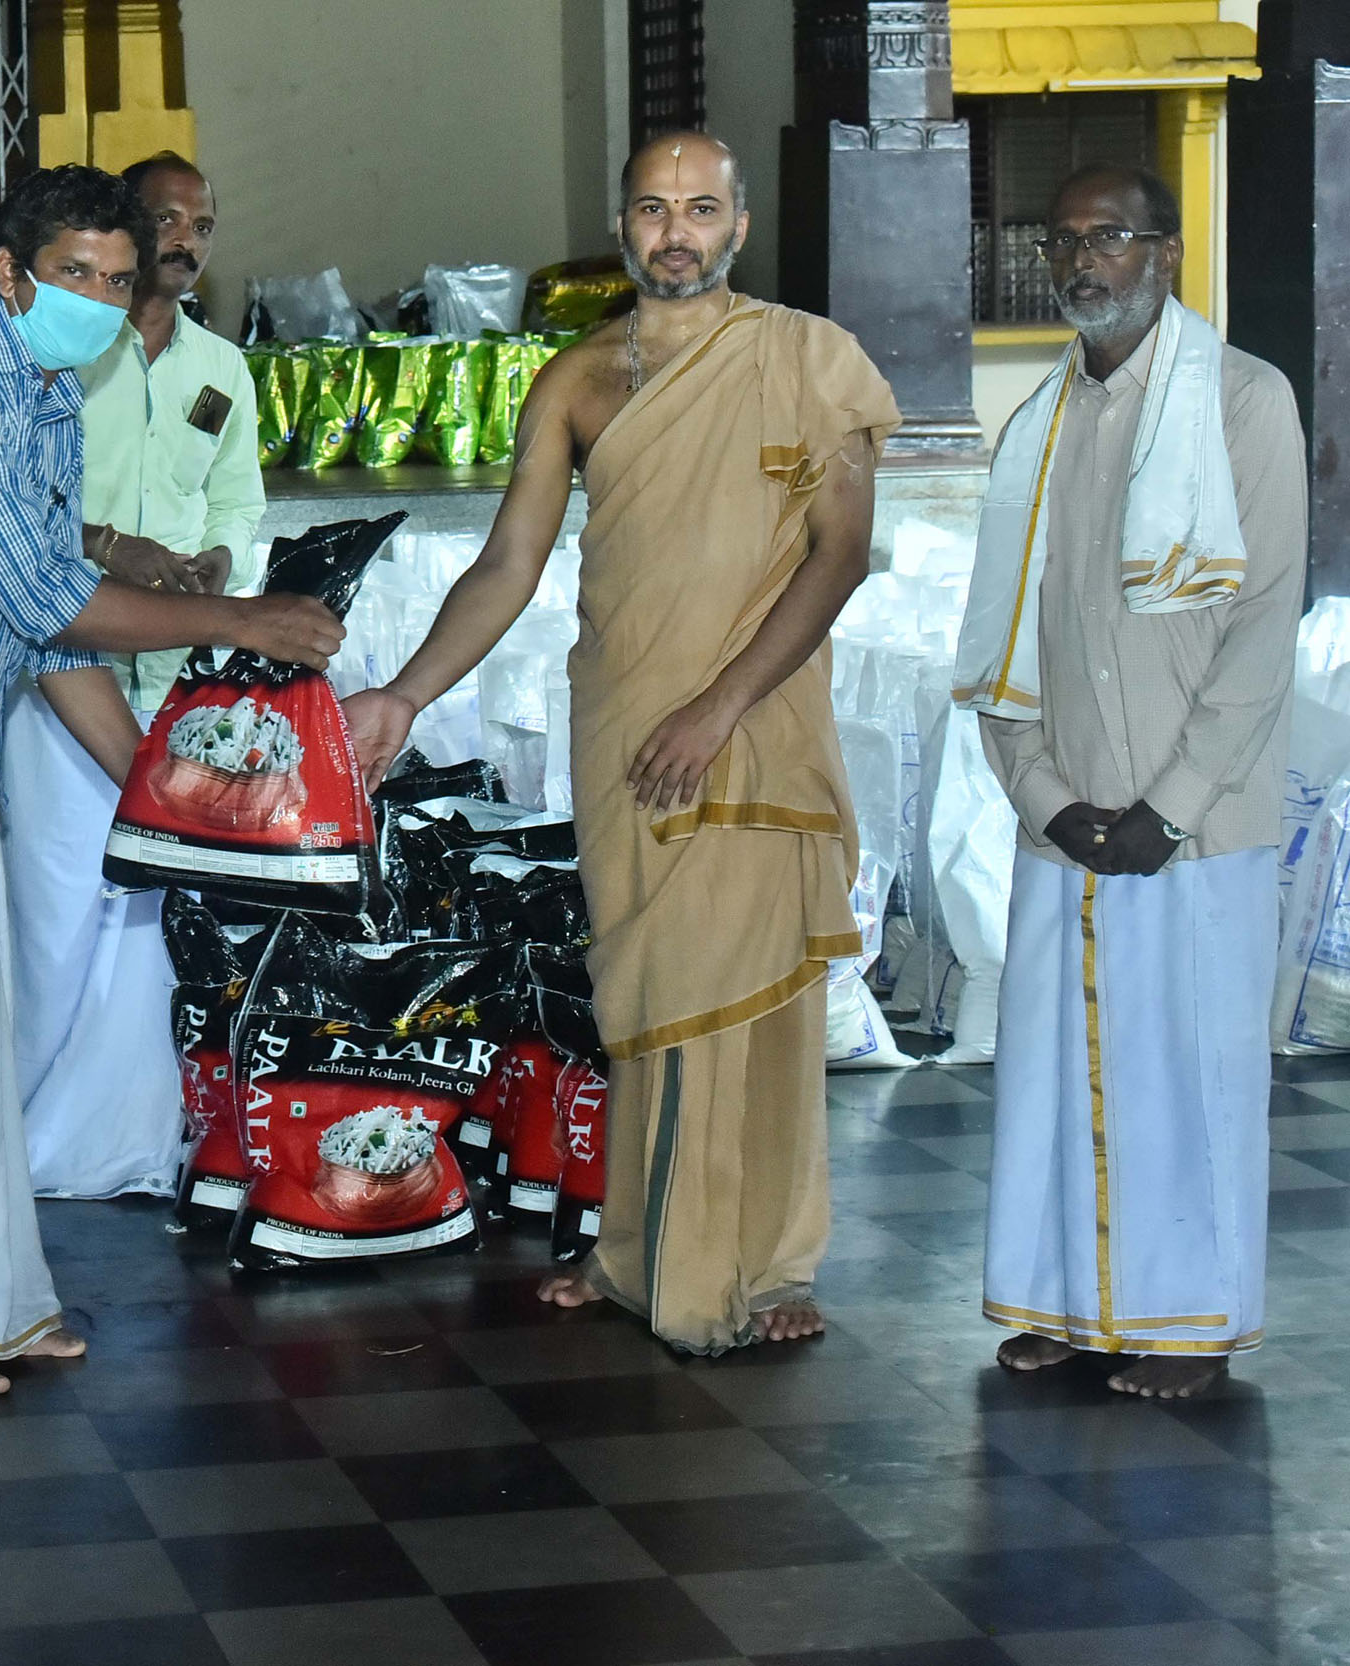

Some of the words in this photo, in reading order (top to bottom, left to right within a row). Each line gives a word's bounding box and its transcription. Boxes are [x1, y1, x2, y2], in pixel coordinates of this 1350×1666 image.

[143, 829, 154, 838] OF
[154, 832, 180, 843] INDIA
[312, 833, 342, 848] 25kg
[307, 1062, 364, 1077] Lachkari
[368, 1066, 415, 1084] Kolam,
[416, 1072, 452, 1091] Jeera
[456, 1081, 476, 1097] Gh
[246, 1028, 290, 1171] PAALK
[204, 1175, 240, 1188] PRODUCE
[518, 1179, 554, 1191] PRODUCE
[266, 1217, 305, 1234] PRODUCE
[305, 1228, 318, 1236] OF
[318, 1230, 344, 1239] INDIA
